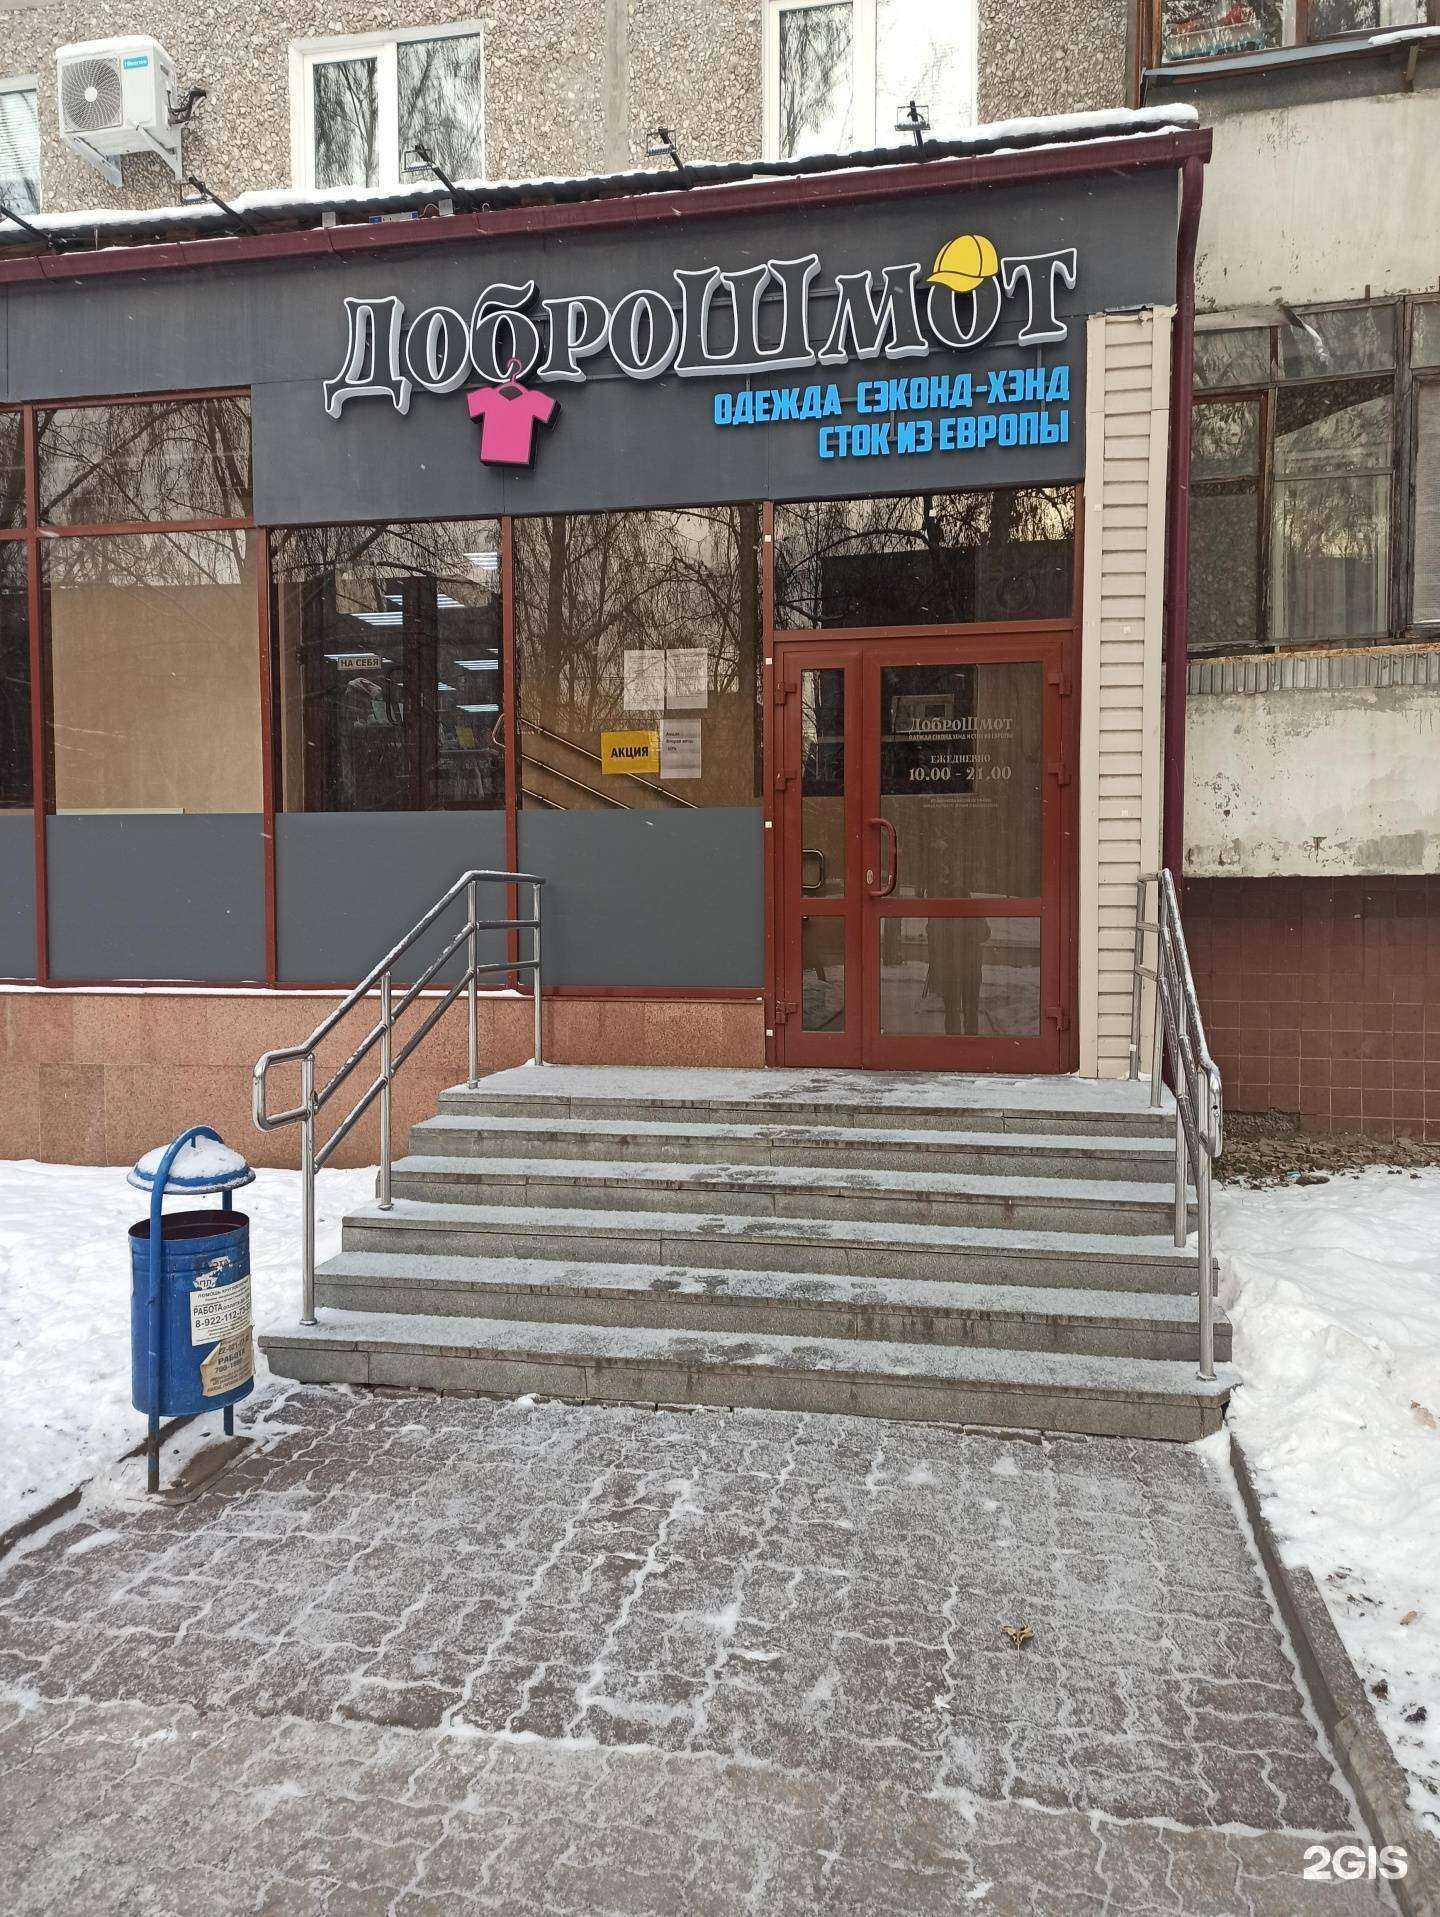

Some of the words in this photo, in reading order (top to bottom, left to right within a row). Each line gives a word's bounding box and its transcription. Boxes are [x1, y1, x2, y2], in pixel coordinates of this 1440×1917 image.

[713, 383, 842, 426] ОДЕЖДА
[857, 365, 1070, 414] СЭКОНД-ХЭНД
[818, 422, 890, 458] СТОК
[897, 420, 933, 454] ИЗ
[939, 410, 1070, 449] ЕВРОПЫ
[341, 659, 354, 667] НА
[356, 658, 379, 667] СЕБЯ
[611, 747, 649, 759] АКЦИЯ
[930, 754, 991, 764] ЕЖЕДНЕВНО
[909, 767, 951, 781] 10.00
[966, 766, 1012, 780] 21.00
[193, 1304, 222, 1316] РАБОТА
